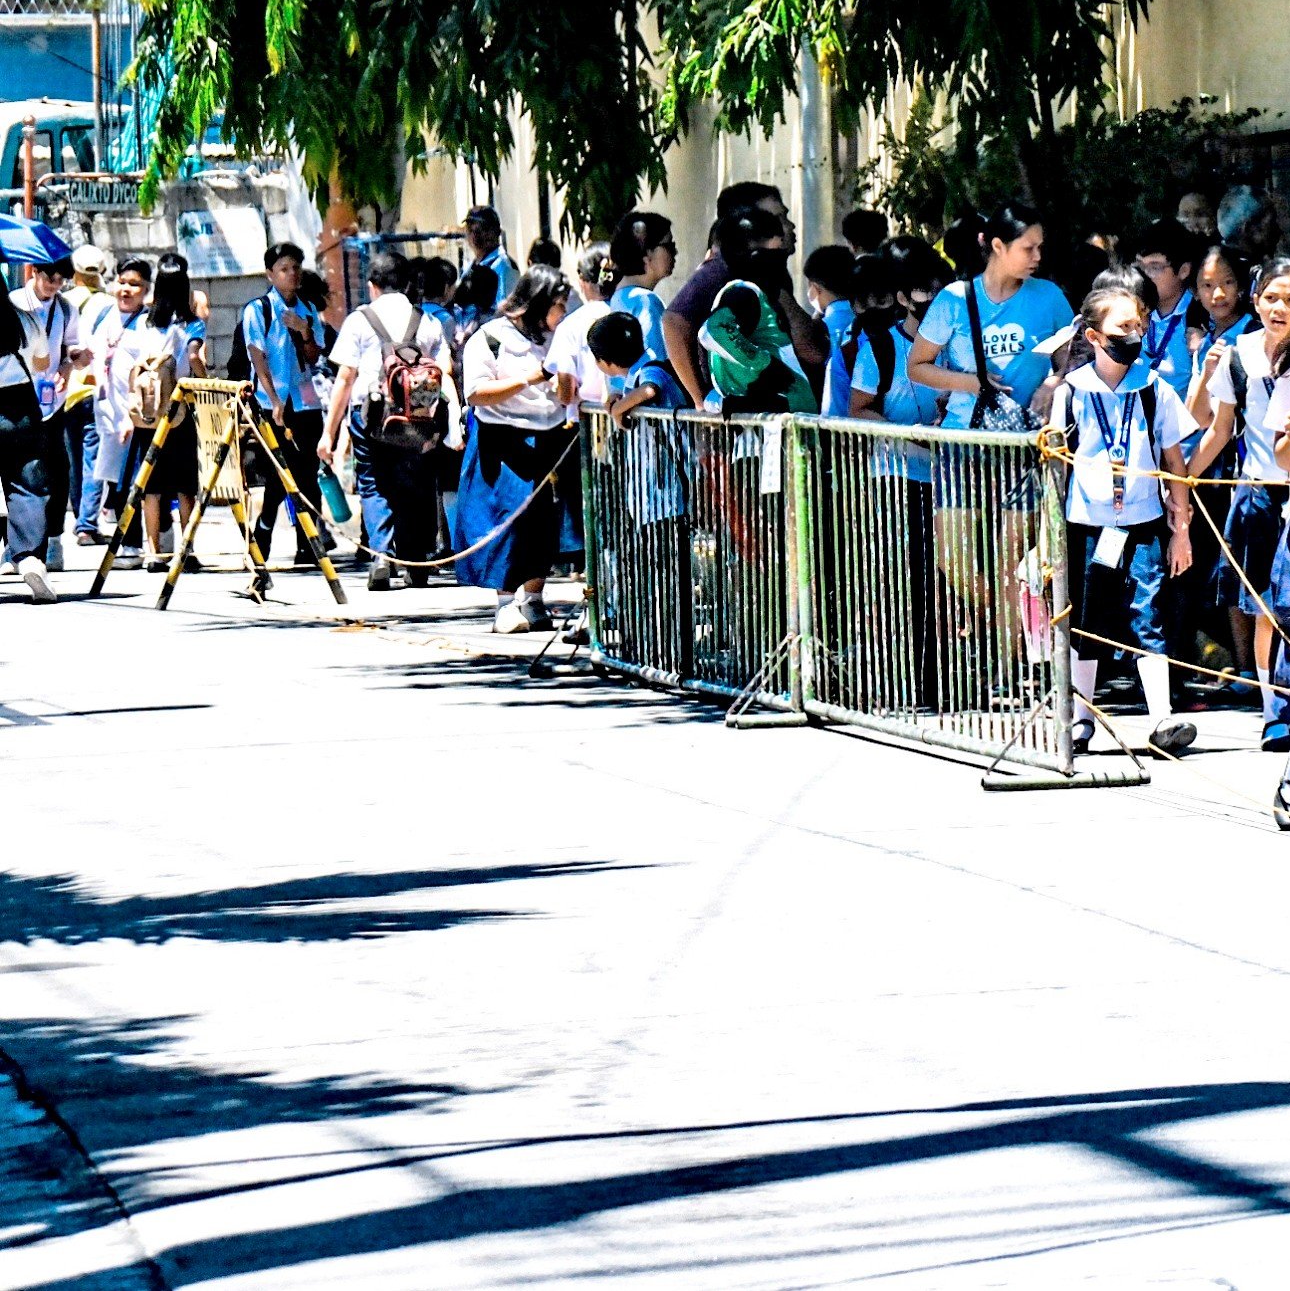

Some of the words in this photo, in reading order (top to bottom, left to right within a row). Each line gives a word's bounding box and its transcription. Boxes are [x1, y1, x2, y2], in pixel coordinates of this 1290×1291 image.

[70, 182, 110, 204] CALIXTO
[112, 182, 138, 204] DYCO
[983, 332, 1019, 344] LOVE
